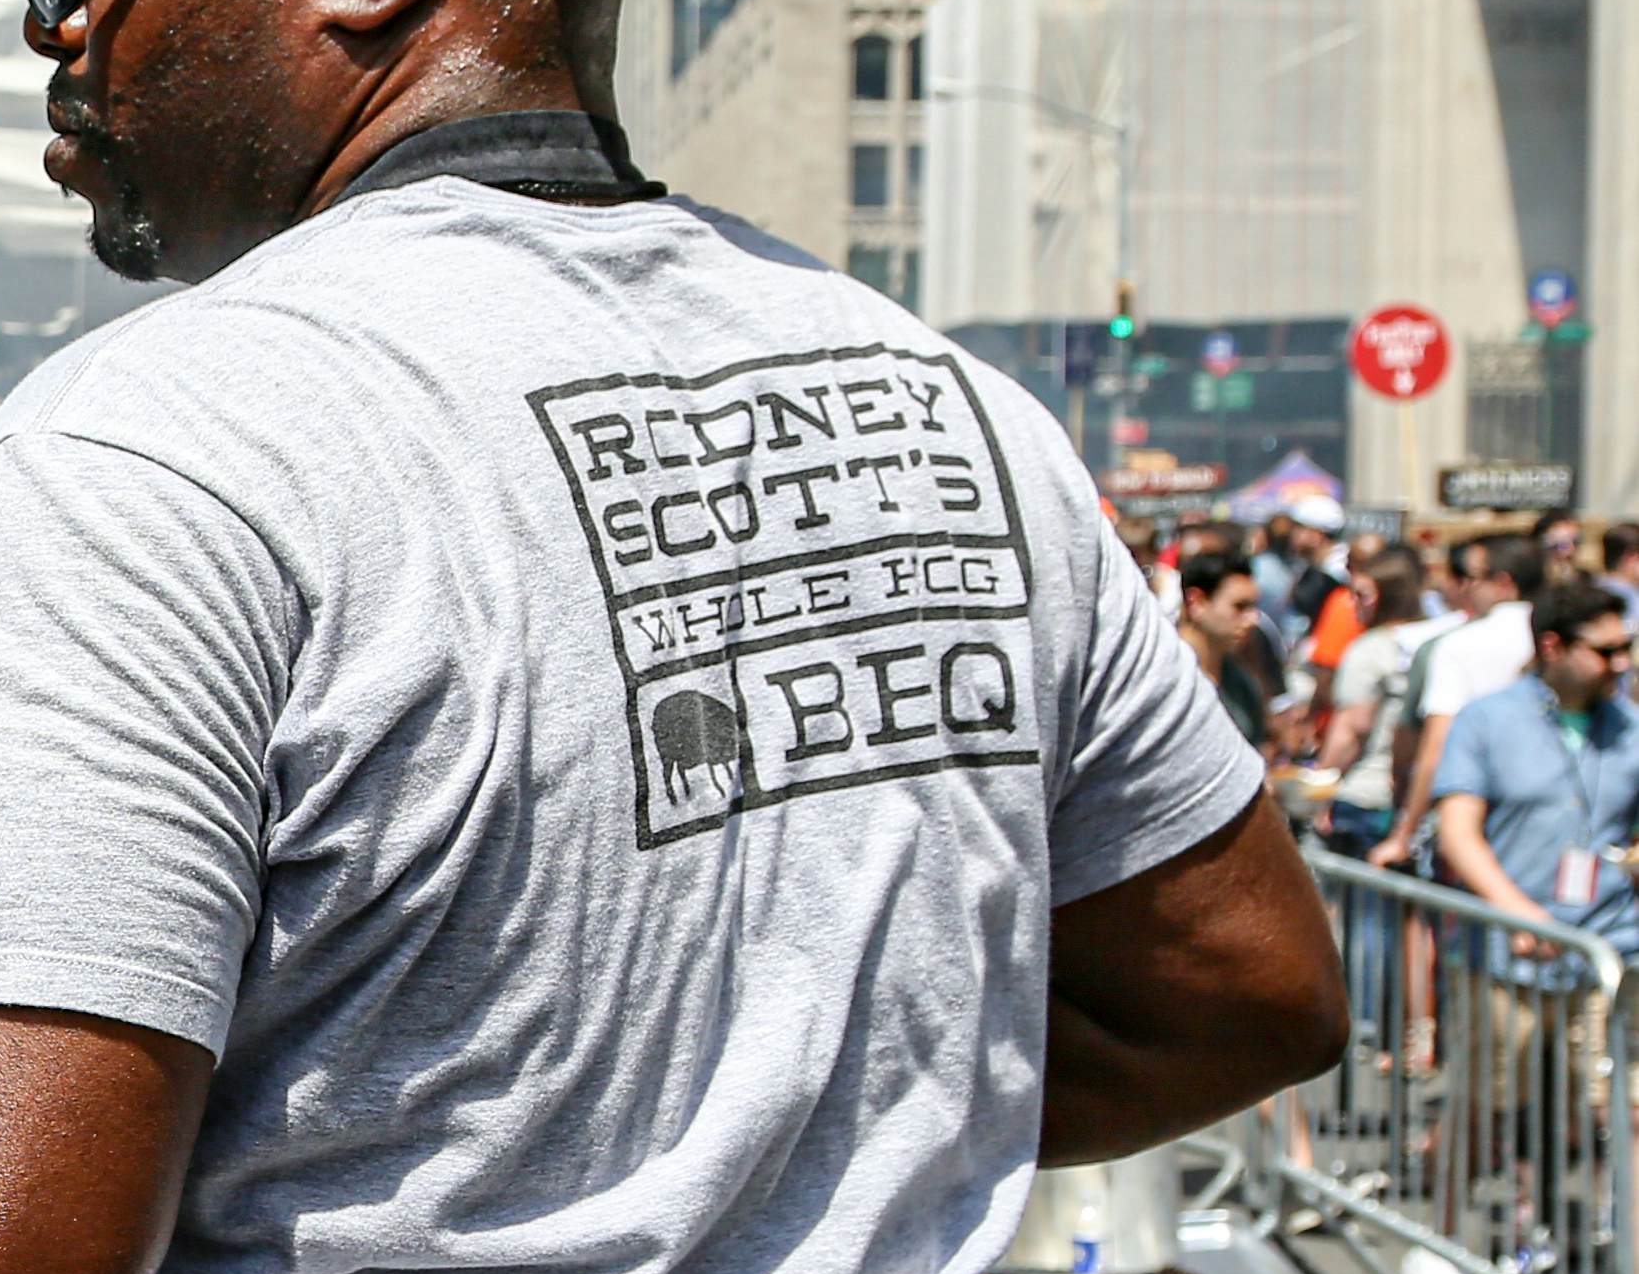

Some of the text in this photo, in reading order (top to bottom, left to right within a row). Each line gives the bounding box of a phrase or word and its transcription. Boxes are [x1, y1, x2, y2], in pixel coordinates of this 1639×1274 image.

[570, 376, 946, 481] RODNEY
[603, 448, 982, 566] SCOTT'S
[632, 570, 851, 652] WHOLE
